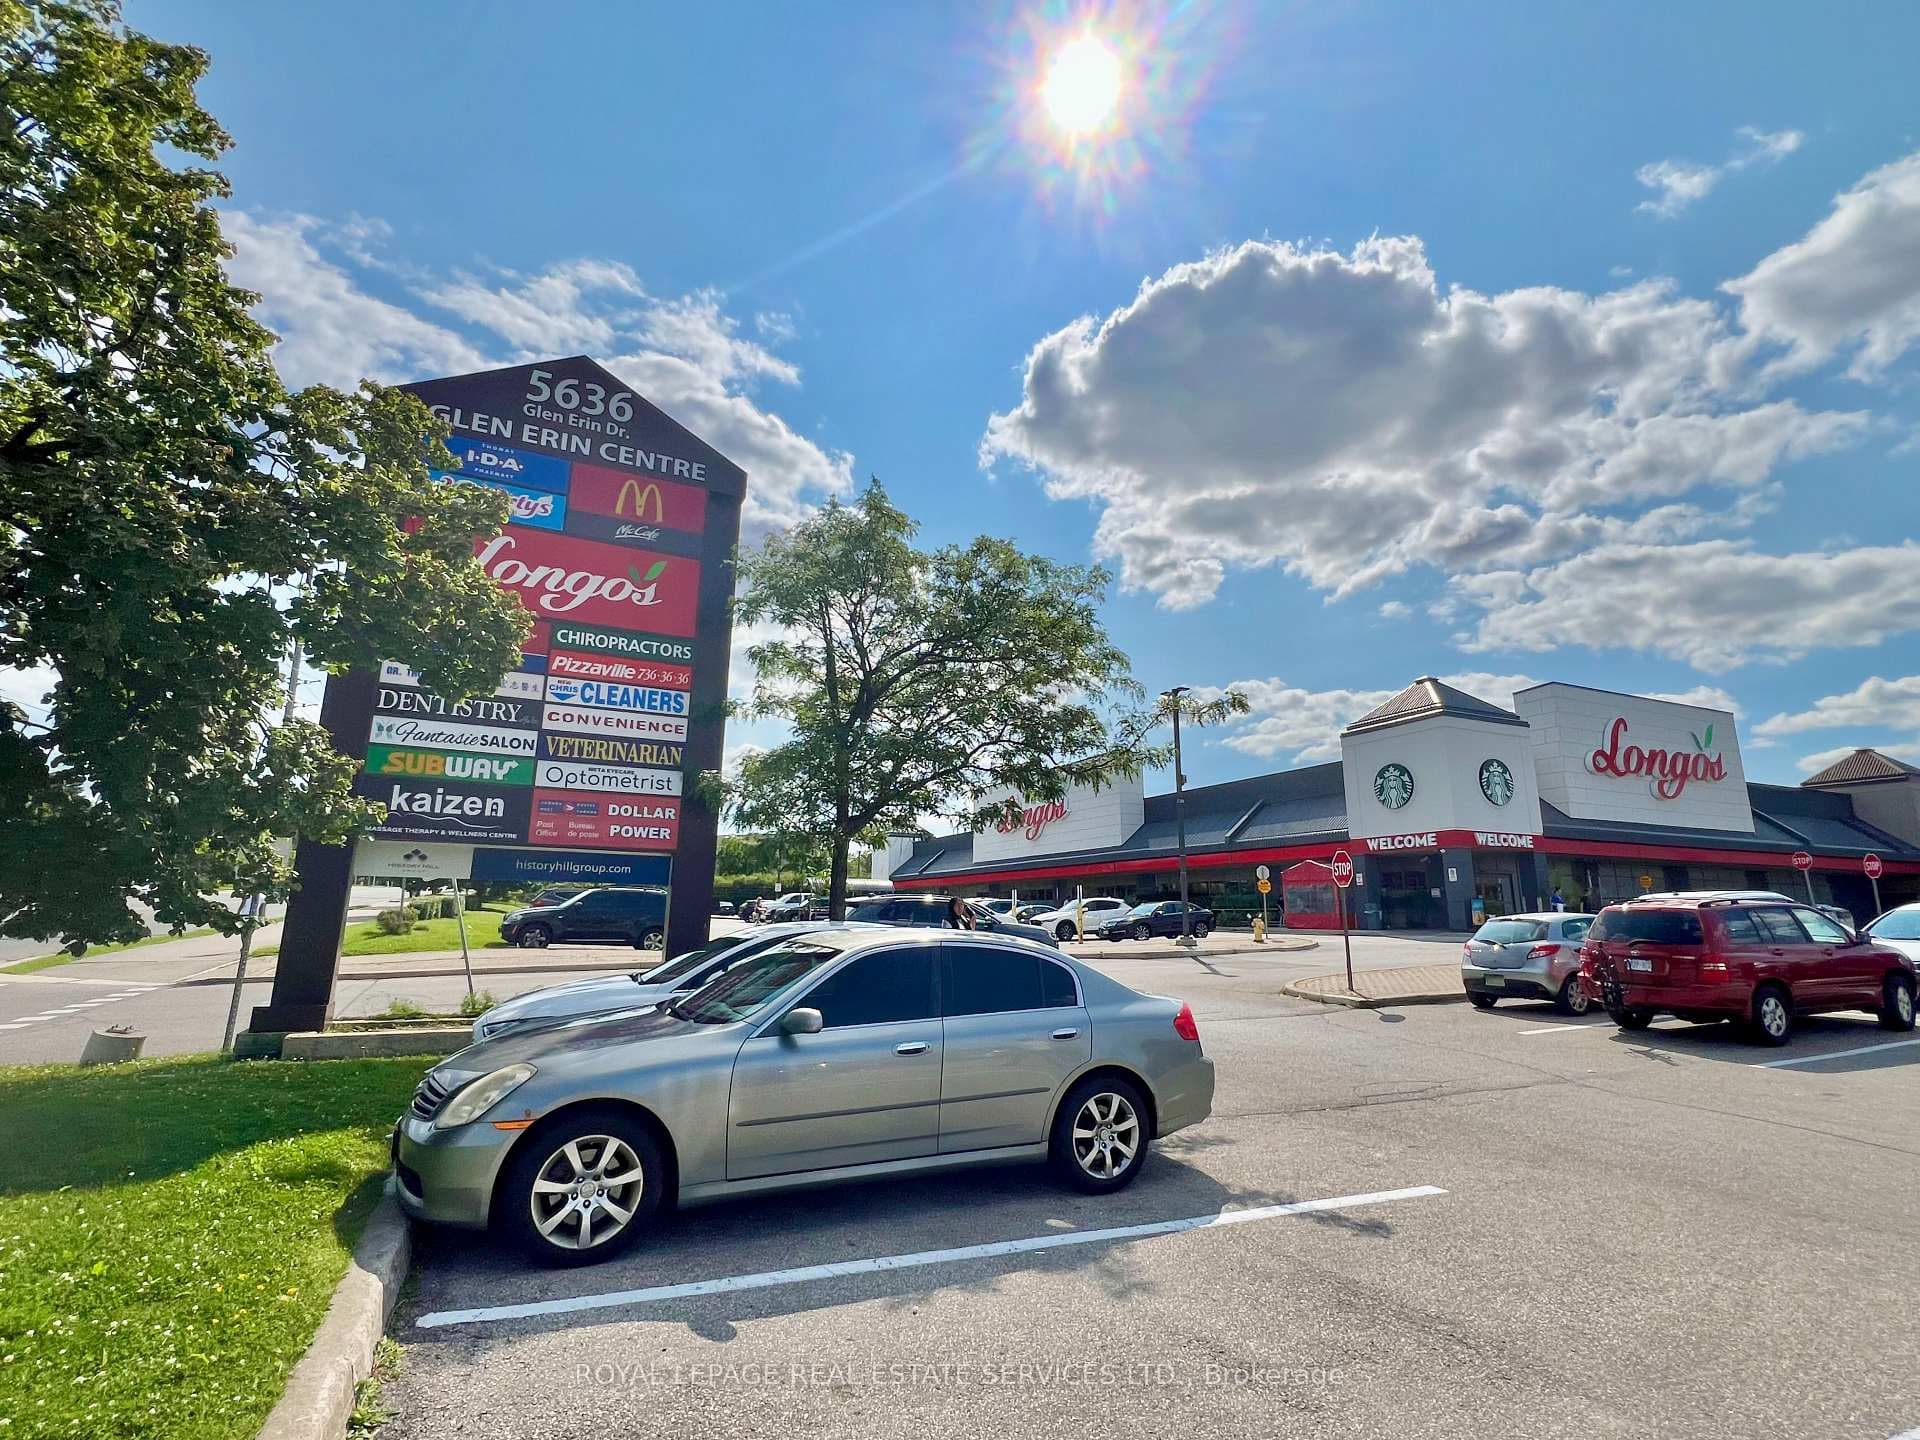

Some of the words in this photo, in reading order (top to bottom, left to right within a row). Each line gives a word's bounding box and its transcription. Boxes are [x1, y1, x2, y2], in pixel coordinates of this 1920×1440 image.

[526, 368, 635, 423] 5636
[522, 403, 564, 424] Glen
[568, 413, 602, 433] Erin
[606, 421, 631, 440] Dr.
[430, 404, 513, 439] GLEN
[521, 422, 592, 457] ERIN
[599, 442, 707, 482] CENTRE
[556, 629, 692, 659] CHIROPRACTORS
[551, 656, 637, 679] Pizzaville
[549, 684, 579, 694] CHRIS
[580, 682, 685, 714] CLEANERS
[376, 688, 523, 723] DENTISTRY
[547, 711, 685, 735] CONVENIENCE
[395, 721, 480, 746] Fantasie
[480, 734, 535, 751] SALON
[545, 735, 684, 767] VETERINARIAN
[381, 751, 520, 781] SUBWAY
[545, 766, 673, 791] Optometrist
[390, 784, 505, 817] kaizen
[608, 803, 677, 820] DOLLAR
[996, 795, 1067, 841] Lngos
[364, 825, 403, 834] MASSAGE
[405, 826, 439, 835] THERAPY
[448, 830, 488, 838] WELLNESS
[489, 831, 519, 840] CENTRE
[609, 824, 671, 840] POWER
[1366, 833, 1438, 850] WELCOME
[1474, 832, 1534, 849] WELCOME
[515, 857, 632, 875] historyhillgroup.com
[1334, 860, 1351, 876] STOP
[1793, 857, 1809, 865] STOP
[1865, 861, 1880, 871] STOP
